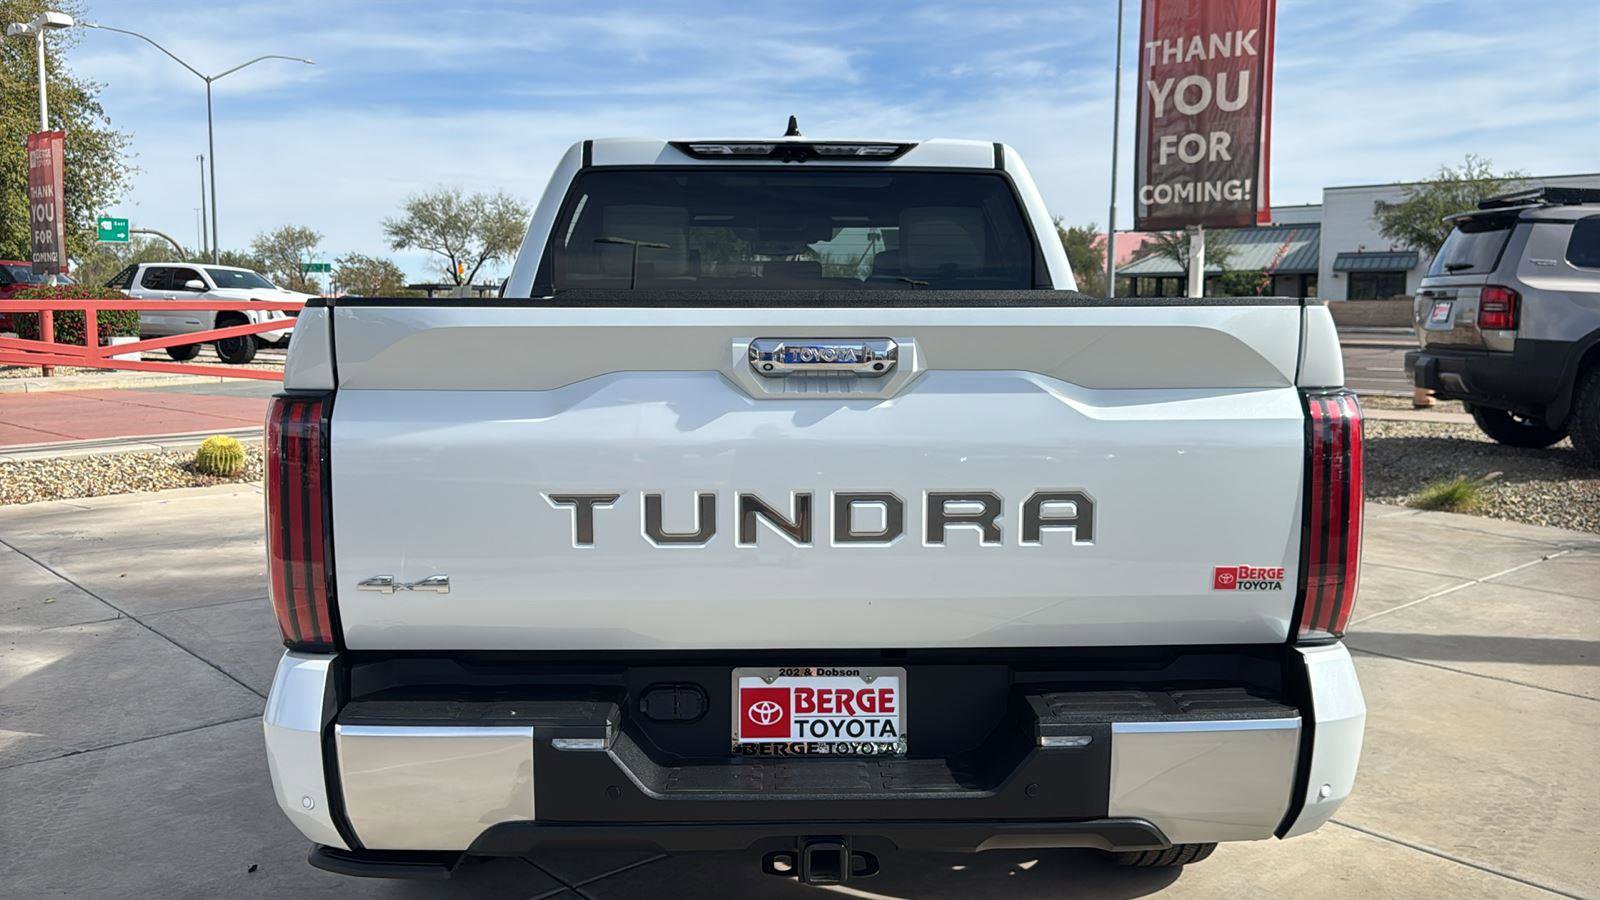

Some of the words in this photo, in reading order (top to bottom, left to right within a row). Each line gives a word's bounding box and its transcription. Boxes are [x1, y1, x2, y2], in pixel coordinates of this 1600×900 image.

[1145, 28, 1258, 67] THANK
[1146, 70, 1250, 119] YOU
[1159, 131, 1232, 166] FOR
[31, 185, 54, 198] THANK
[1138, 178, 1252, 206] COMING!
[32, 203, 54, 222] YOU
[35, 230, 52, 244] FOR
[33, 252, 58, 262] COMING!
[789, 347, 858, 363] TOYOTA
[540, 487, 1097, 549] TUNDRA
[1237, 581, 1282, 591] TOYOTA
[779, 668, 800, 677] 202
[804, 668, 812, 677] &
[817, 668, 860, 677] Dobson
[794, 687, 895, 716] BERGE
[794, 719, 897, 738] TOYOTA
[742, 742, 819, 756] BERGE
